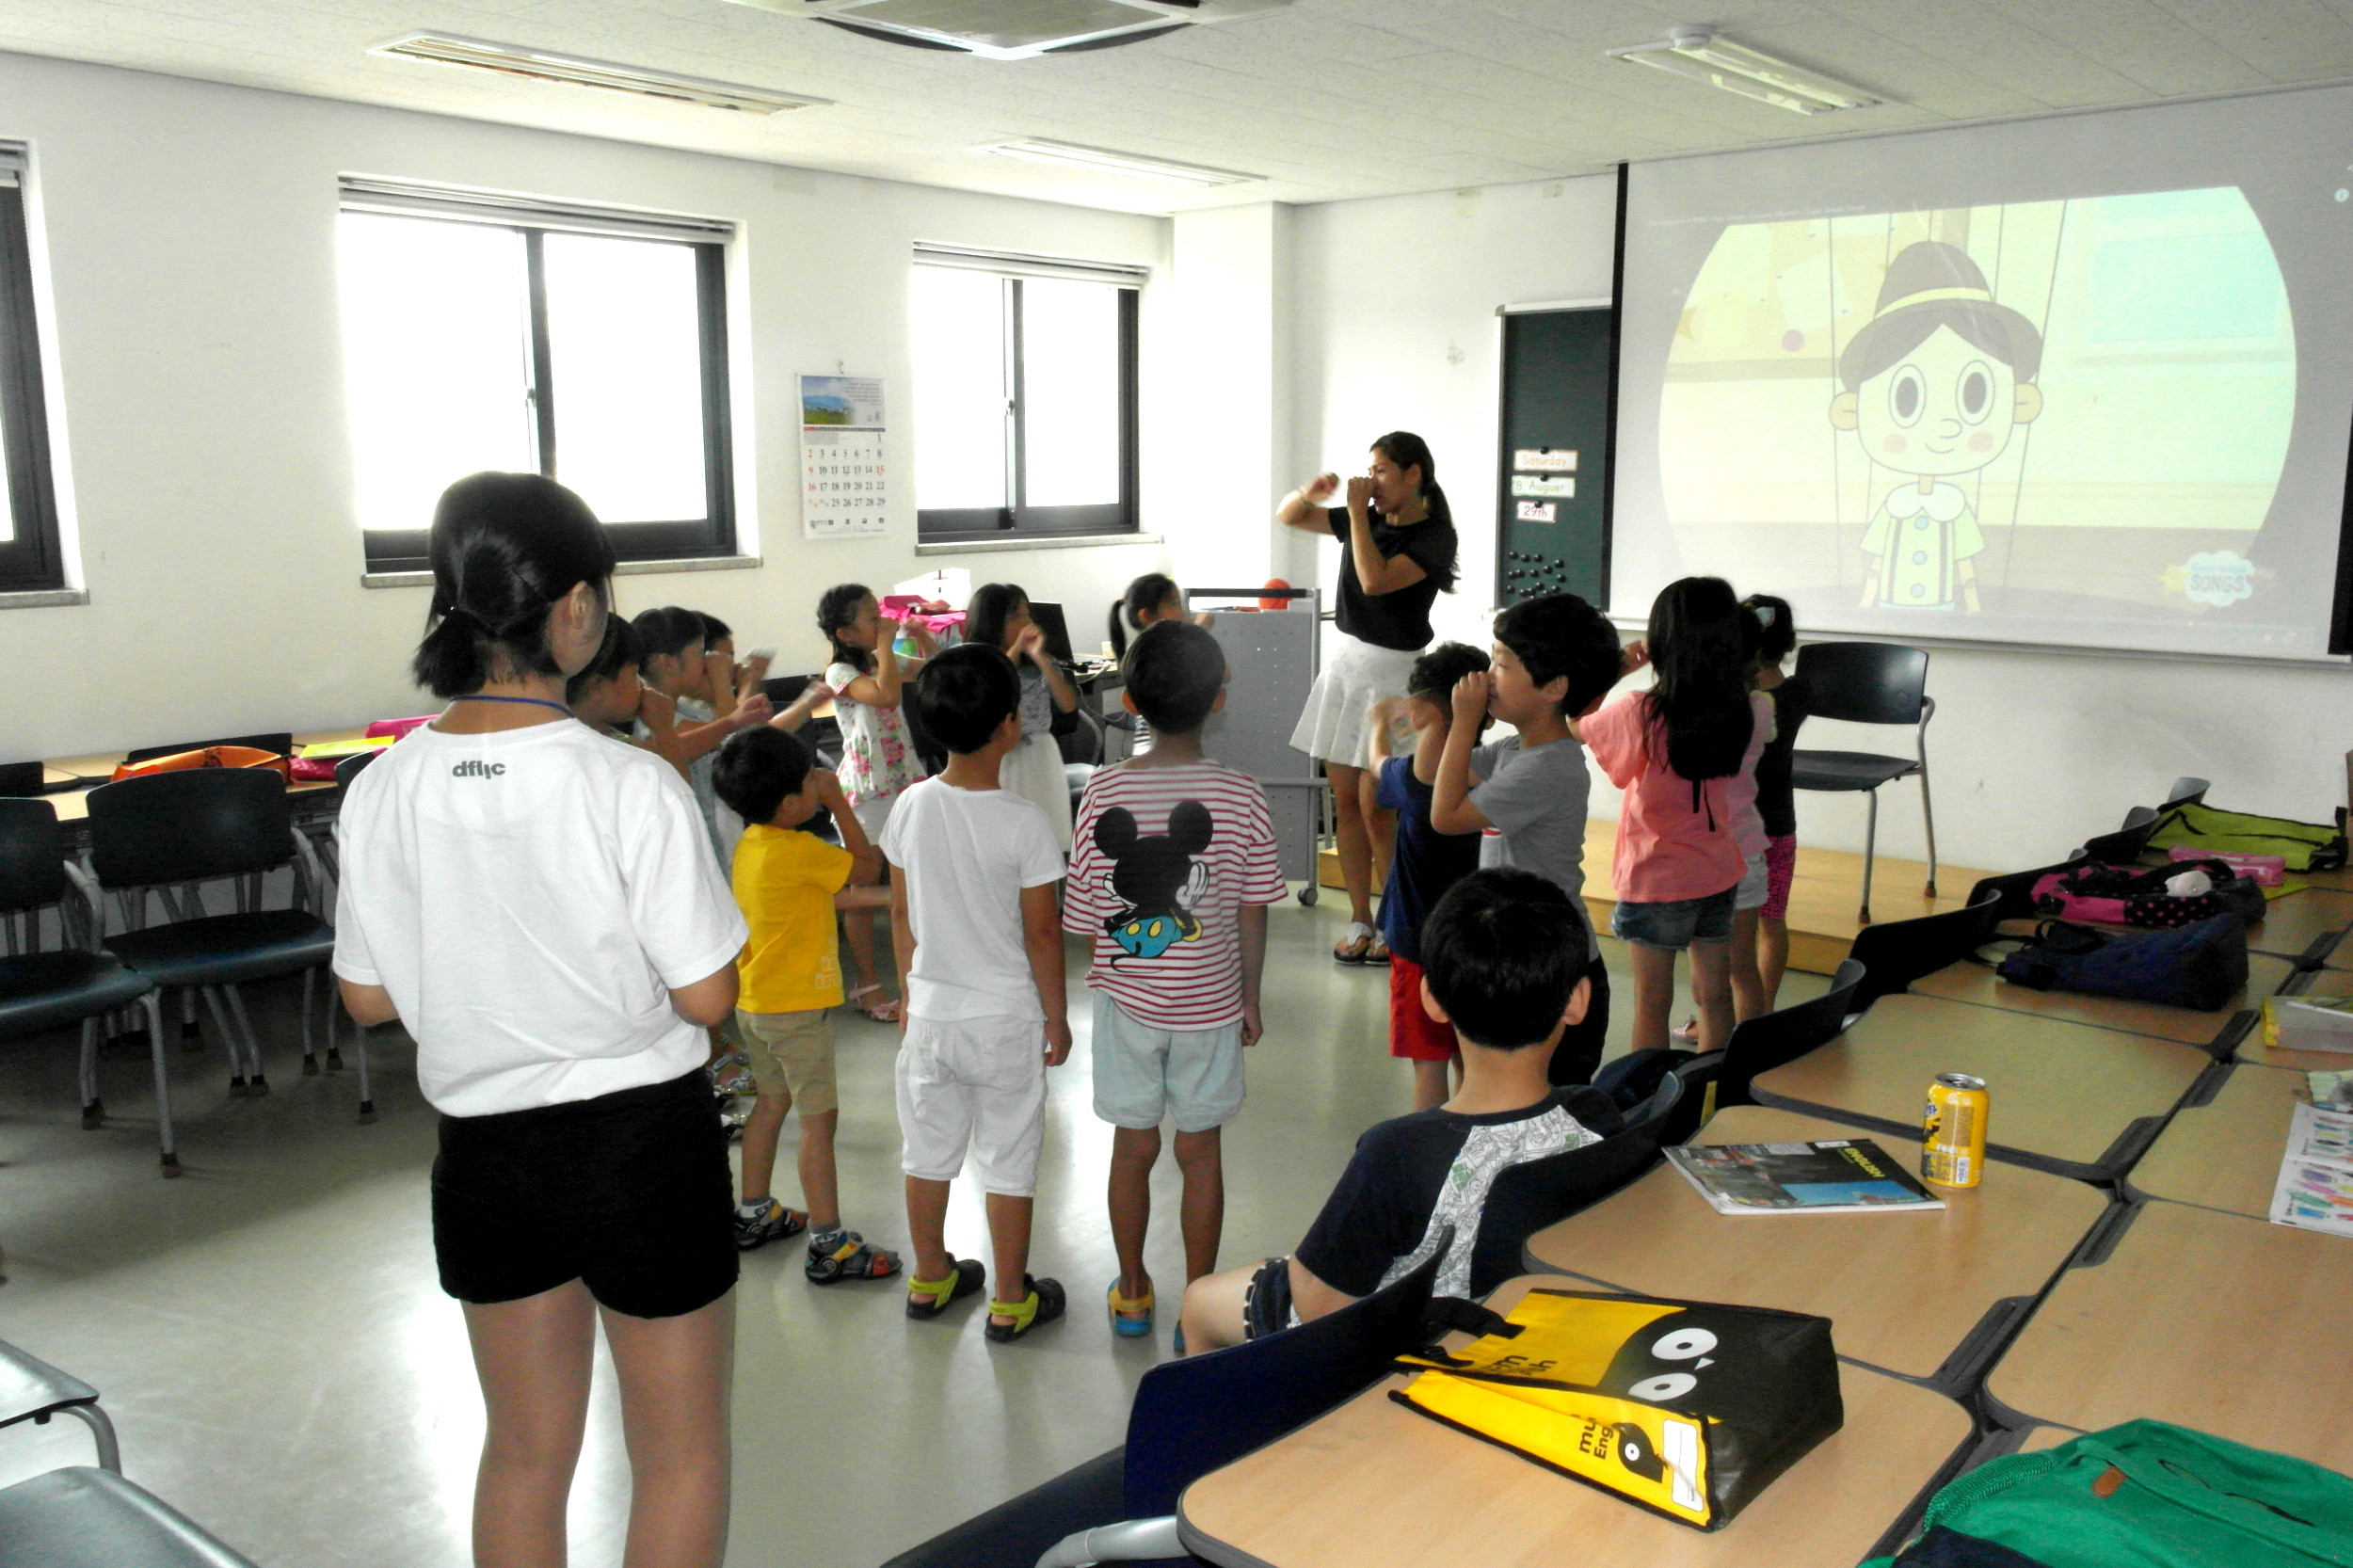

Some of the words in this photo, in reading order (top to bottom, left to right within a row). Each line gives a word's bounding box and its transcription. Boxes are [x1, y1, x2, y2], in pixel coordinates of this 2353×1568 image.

[808, 449, 812, 458] 2
[820, 449, 824, 458] 3
[832, 449, 837, 458] 4
[843, 449, 848, 458] 5
[854, 449, 859, 458] 6
[866, 449, 871, 458] 7
[876, 449, 883, 458] 8
[1522, 454, 1567, 467] Saturday
[808, 466, 814, 474] 9
[819, 466, 827, 474] 10
[831, 466, 839, 474] 11
[842, 466, 850, 474] 12
[854, 466, 862, 474] 13
[865, 466, 873, 474] 14
[876, 466, 885, 474] 15
[808, 483, 816, 491] 16
[820, 483, 828, 491] 17
[831, 483, 840, 491] 18
[843, 482, 851, 490] 19
[854, 482, 862, 490] 20
[865, 482, 873, 490] 21
[876, 482, 885, 490] 22
[1515, 480, 1522, 491] 8
[1529, 480, 1564, 494] August
[831, 499, 840, 507] 25
[843, 499, 852, 507] 26
[855, 499, 863, 507] 27
[866, 498, 874, 506] 28
[876, 498, 886, 506] 29
[1524, 505, 1547, 518] 29th
[2190, 574, 2245, 592] SONGS
[1578, 1416, 1596, 1454] mu
[1593, 1426, 1614, 1460] Eng
